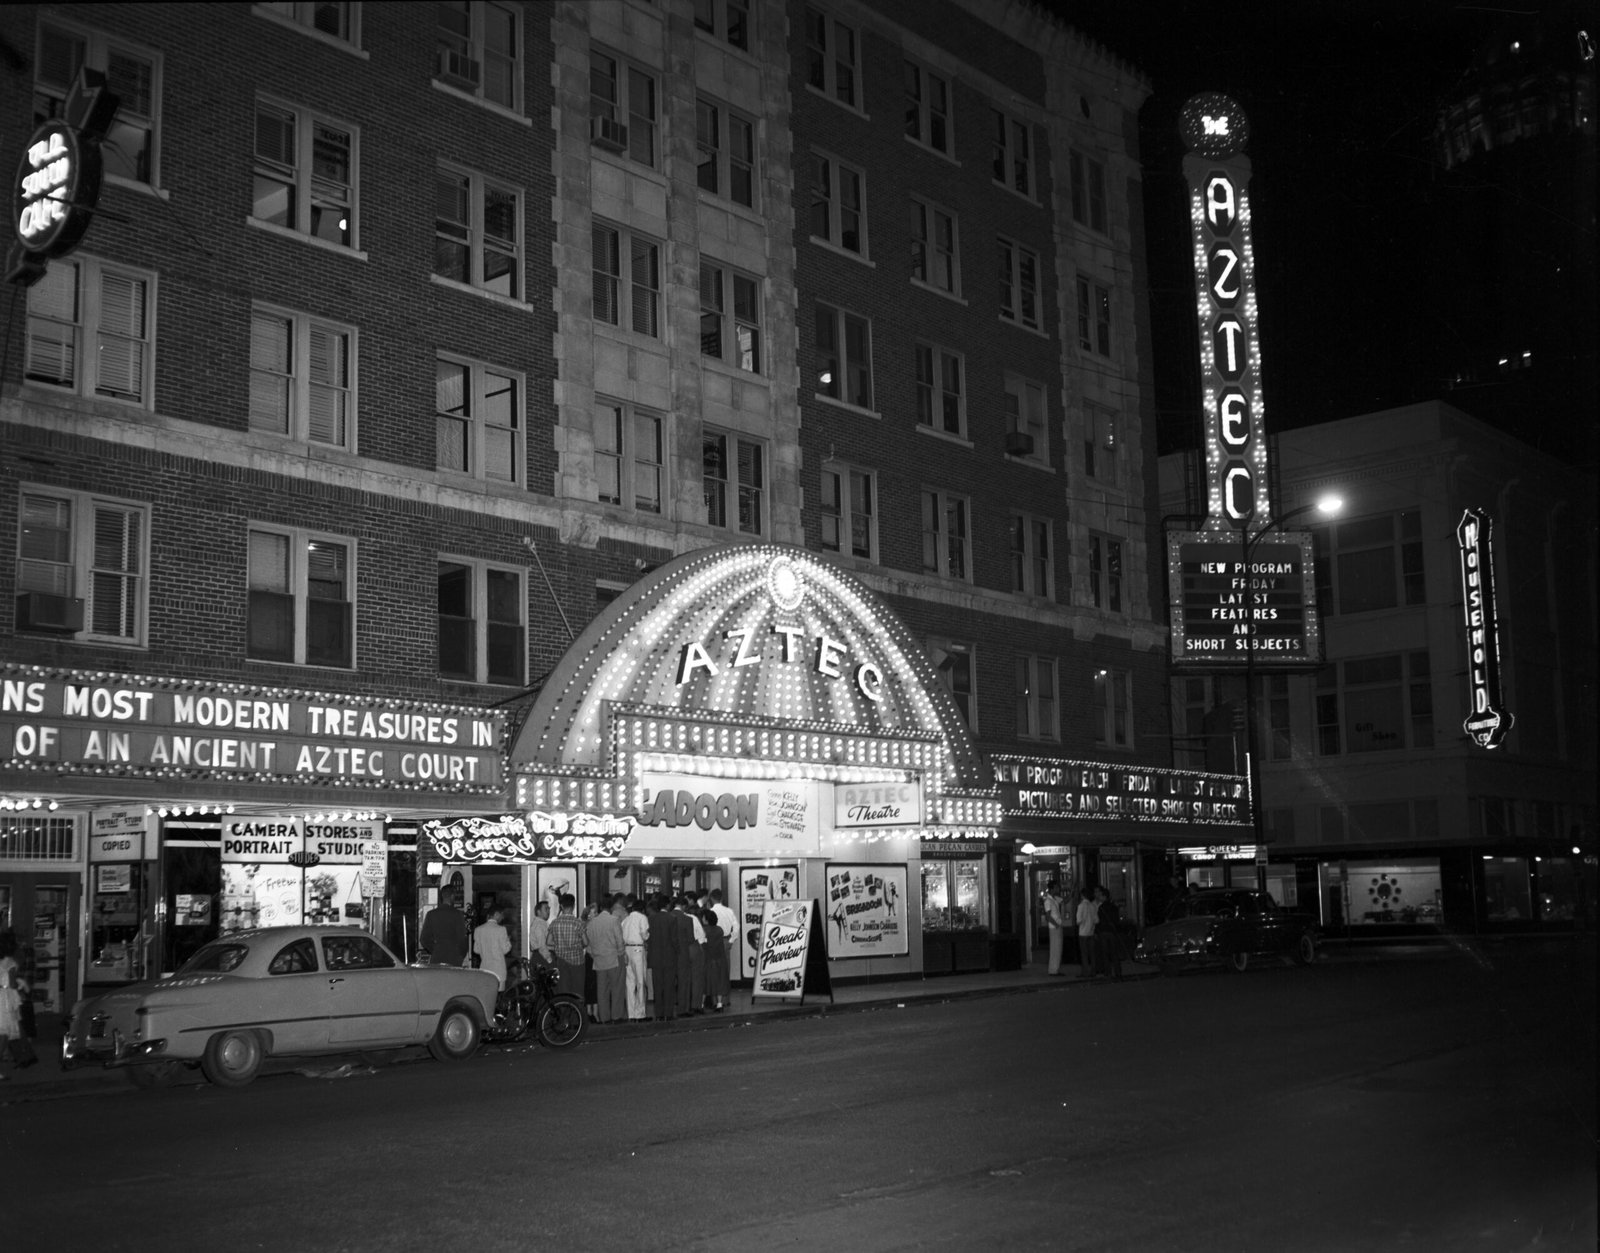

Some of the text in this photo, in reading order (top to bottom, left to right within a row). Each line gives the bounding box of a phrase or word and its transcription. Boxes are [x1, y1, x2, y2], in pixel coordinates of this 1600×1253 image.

[1202, 116, 1230, 136] THE
[1205, 177, 1253, 521] AZTEC
[1200, 562, 1226, 574] NEW
[1232, 578, 1276, 590] FRDAY
[1219, 593, 1269, 605] LATST
[1464, 523, 1487, 713] HOUSEHOLD
[1186, 638, 1226, 650] SHORT
[678, 624, 884, 702] AZTEC
[0, 679, 493, 747] NS MOST MODERN TREASURES IN
[14, 725, 479, 781] OF AN ANCIENT AZTEC COURT
[994, 764, 1020, 784] NEW
[1081, 770, 1110, 789] EACH
[1122, 775, 1158, 793] FRIDAY
[1170, 779, 1205, 796] LATEST
[844, 786, 910, 806] AZTEC
[1018, 790, 1238, 819] PICTURES AND SELECTED SHORT SUBJECTS
[847, 804, 901, 822] Theatre
[231, 822, 374, 839] CAMERA STORES AND
[102, 840, 130, 851] COPIED
[223, 840, 293, 854] PORTRAIT
[939, 843, 962, 851] PECAN
[1209, 845, 1238, 854] QUEEN
[765, 922, 805, 950] Sneak
[760, 945, 807, 971] Preview
